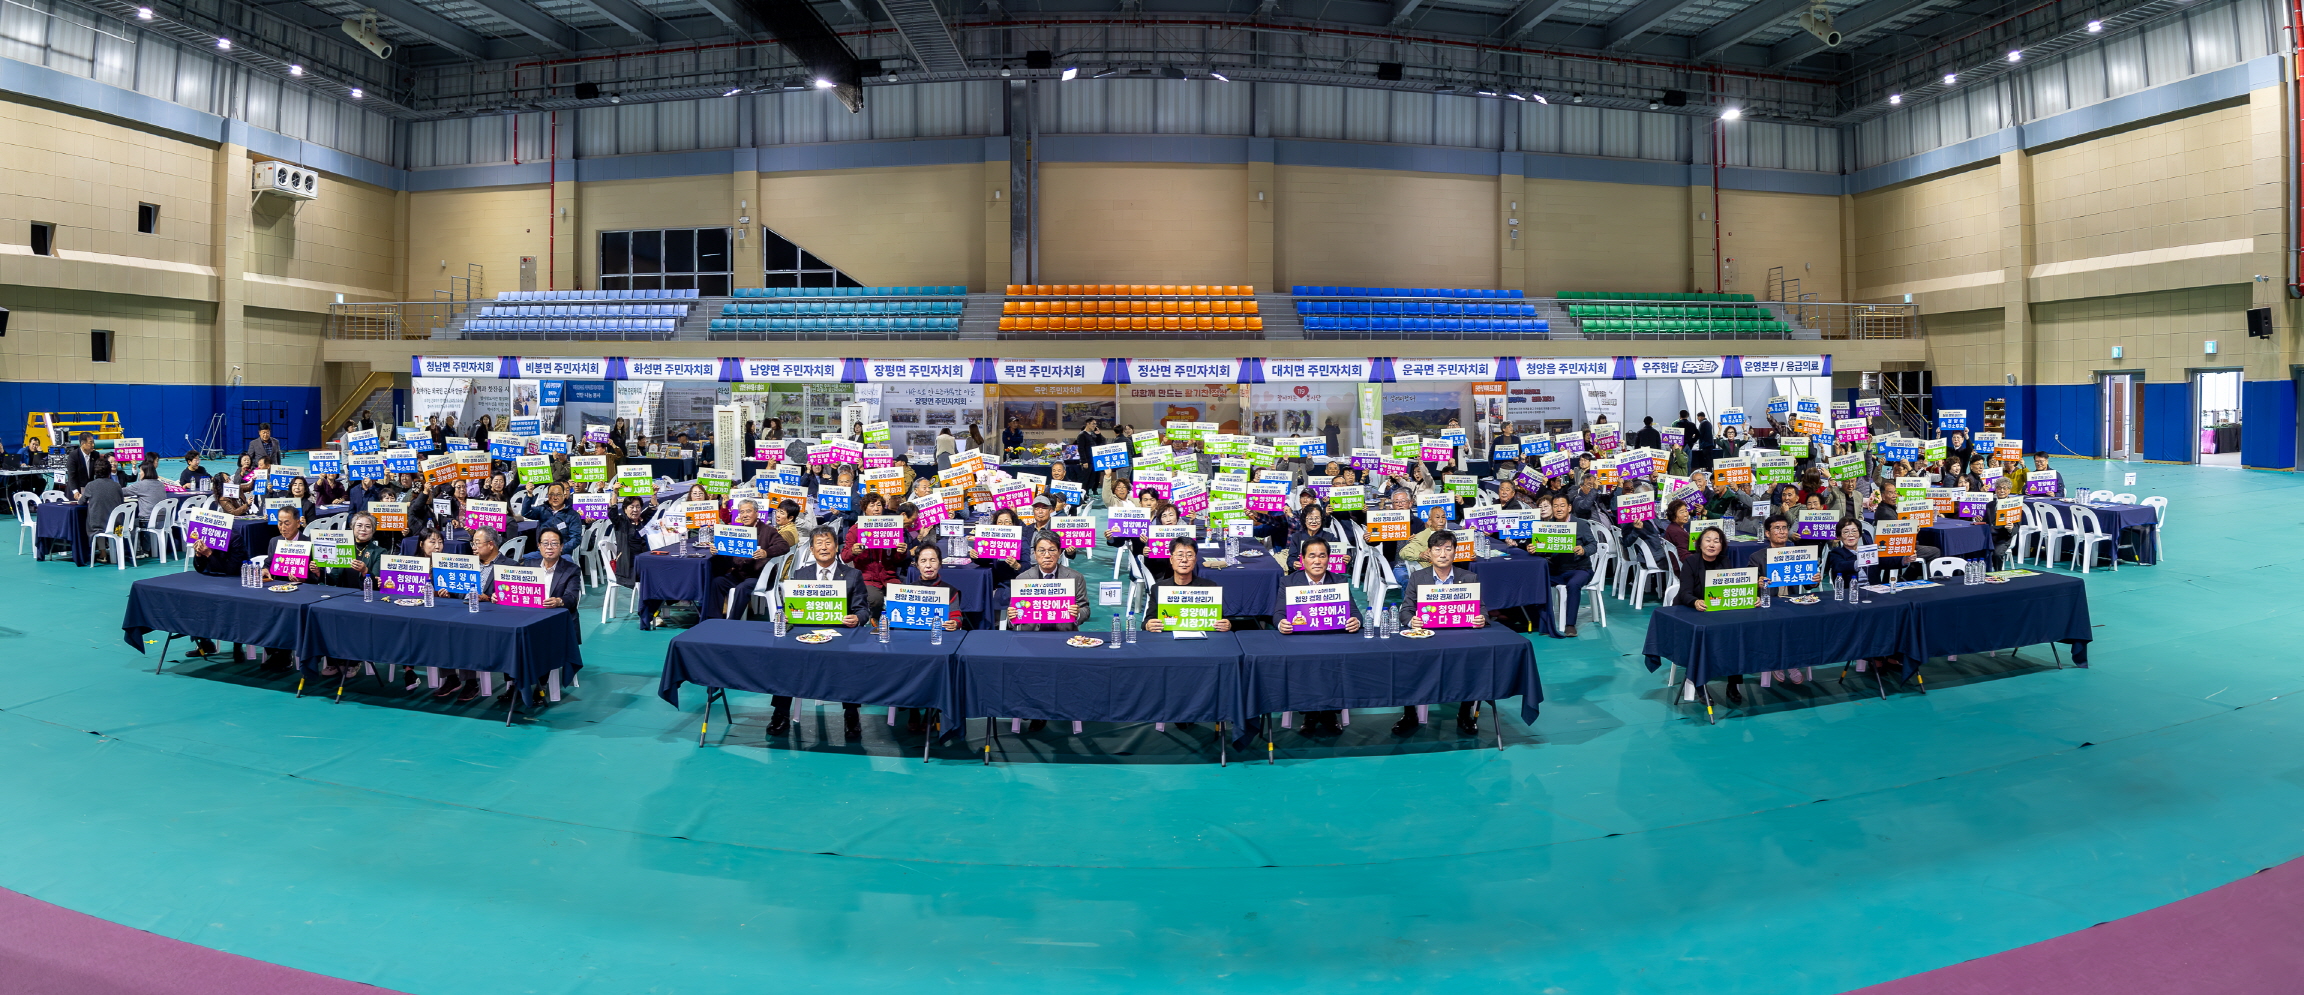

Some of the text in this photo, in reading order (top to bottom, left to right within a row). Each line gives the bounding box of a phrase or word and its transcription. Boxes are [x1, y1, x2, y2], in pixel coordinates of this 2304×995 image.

[427, 362, 493, 372] 청남면 주민자치회
[526, 362, 599, 374] 비봉면 주민자치회
[634, 363, 713, 375] 화성면 주민자치회
[750, 364, 834, 377] 남양면 주민자치회
[874, 364, 963, 377] 장평면 주민자치회
[1004, 365, 1085, 377] 목면 주민자치회
[1138, 365, 1230, 378] 정산면 주민자치회
[1272, 364, 1362, 377] 대치면 주민자치회
[1402, 363, 1488, 376] 운곡면 주민자치회
[1526, 362, 1606, 374] 청양읍 주민자치회
[1642, 362, 1678, 374] 우주현답
[1745, 361, 1819, 372] 운영본부 / 응급의료
[1132, 389, 1227, 397] 다함께 만드는 활기찬 정산
[201, 526, 228, 539] 청양에서
[990, 541, 1017, 549] 청양에서
[398, 574, 426, 583] 청양에서
[1784, 574, 1813, 583] 주소투자
[511, 584, 541, 595] 청양에서
[1723, 588, 1754, 596] 청양에서
[1323, 593, 1341, 601] 살리기
[1723, 597, 1753, 607] 시장가자
[806, 602, 842, 610] 청양에서
[1032, 600, 1070, 609] 청양에서
[1439, 604, 1475, 613] 청양에서
[1180, 608, 1217, 617] 청양에서
[1309, 605, 1346, 616] 청양에서
[806, 612, 843, 621] 시장가자
[1180, 618, 1217, 628] 시장가자
